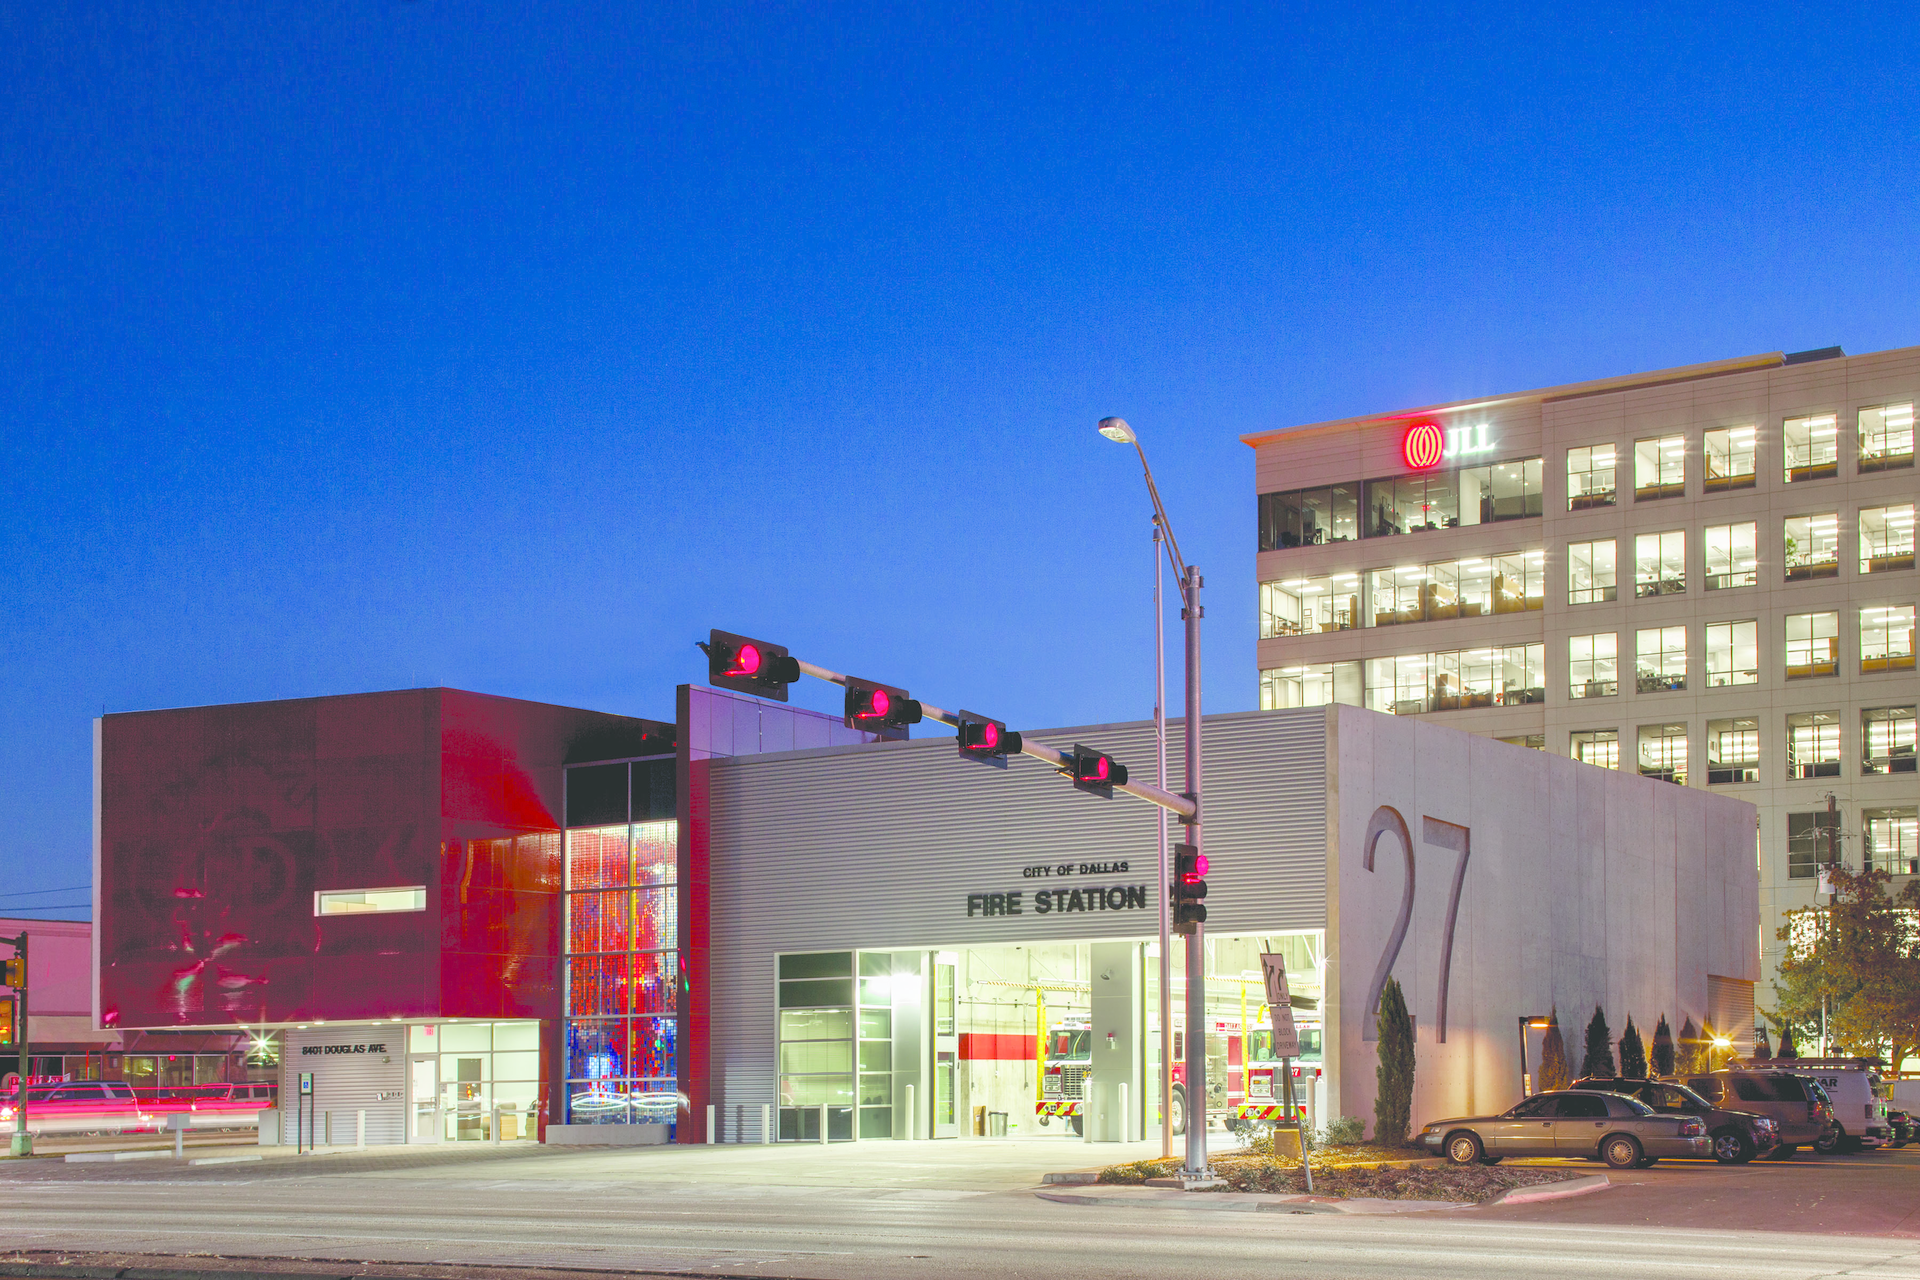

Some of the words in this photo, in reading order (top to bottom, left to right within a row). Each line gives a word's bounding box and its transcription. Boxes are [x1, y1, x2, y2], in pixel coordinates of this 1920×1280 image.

[1443, 424, 1496, 457] JLL
[1023, 866, 1051, 878] CITY
[1057, 865, 1074, 876] OF
[1079, 862, 1129, 875] DALLAS
[967, 892, 1023, 917] FIRE
[1034, 885, 1146, 915] STATION
[1363, 805, 1471, 1044] 27
[1277, 992, 1289, 1000] ONLY
[1274, 1013, 1281, 1022] DO
[1281, 1013, 1291, 1021] NOT
[1278, 1027, 1292, 1036] BLOCK
[302, 1045, 323, 1056] 8401
[324, 1044, 366, 1055] DOUGLAS
[1276, 1041, 1297, 1050] DRIVEWAY
